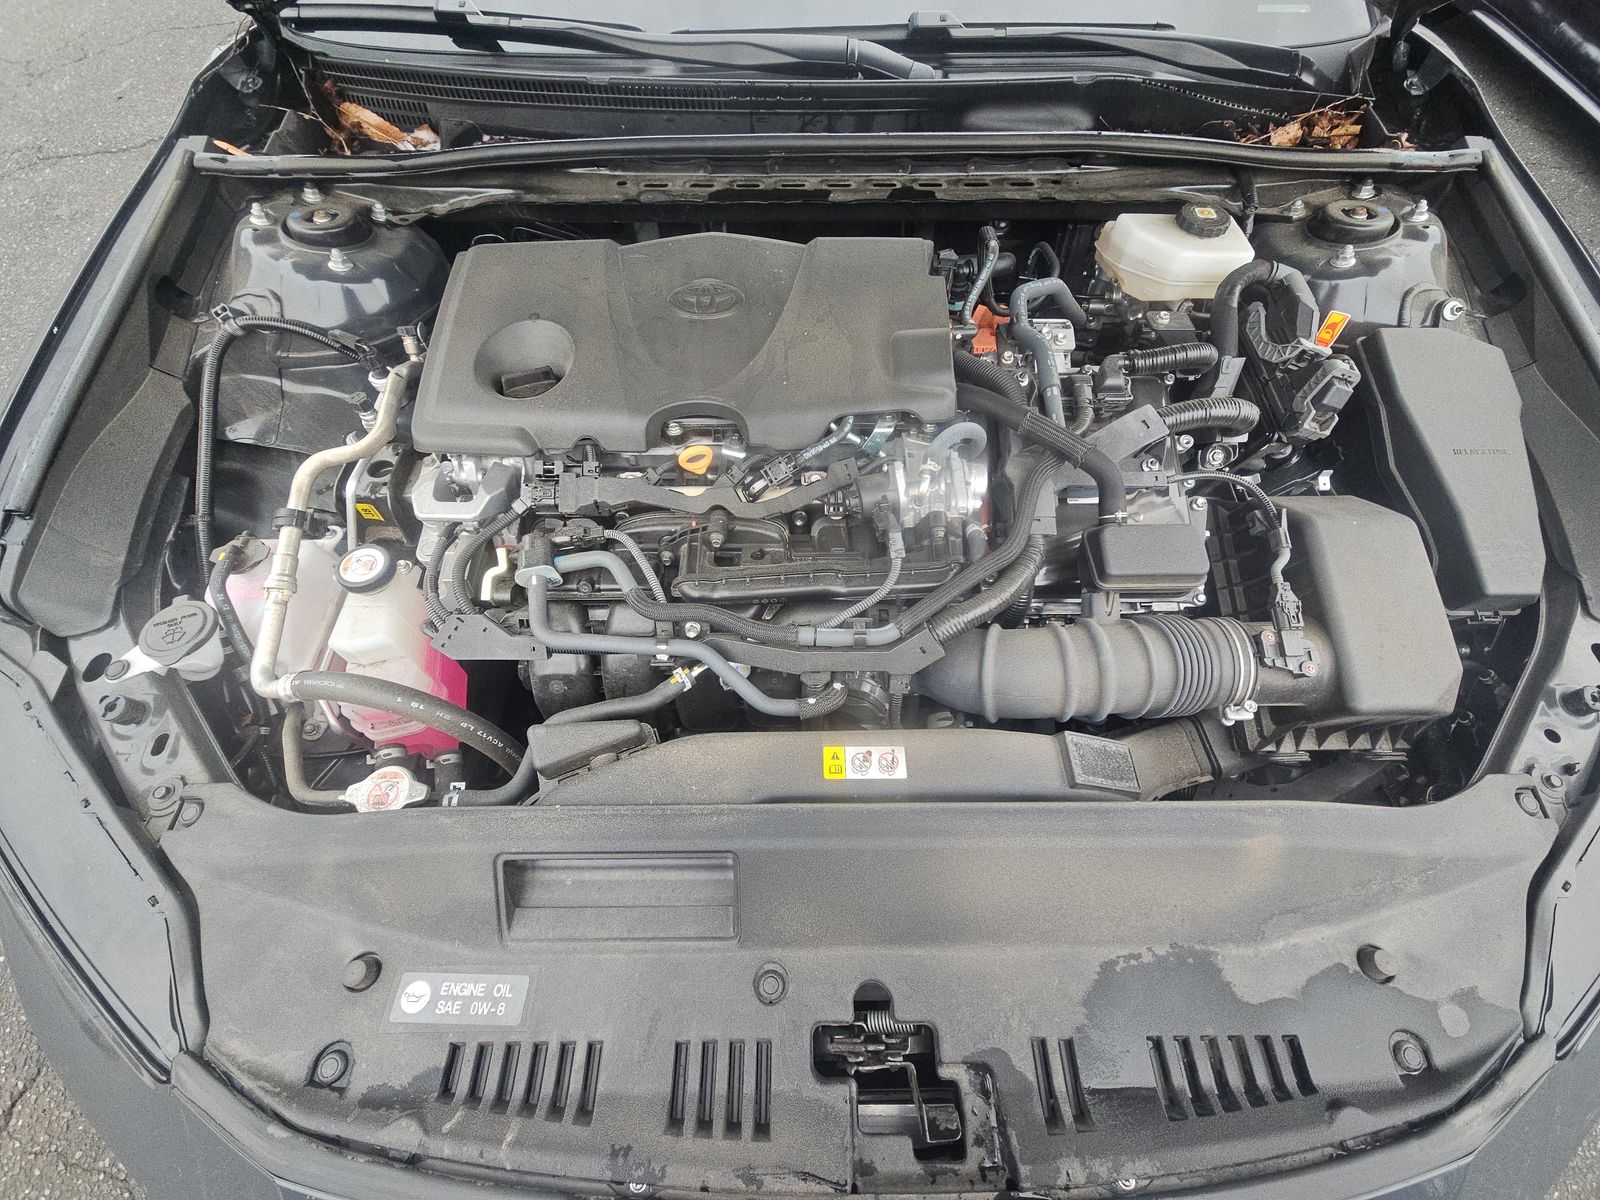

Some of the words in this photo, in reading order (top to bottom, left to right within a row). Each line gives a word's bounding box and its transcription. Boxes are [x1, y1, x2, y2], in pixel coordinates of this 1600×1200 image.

[1452, 448, 1480, 456] RELAY
[476, 730, 504, 748] ACV17
[439, 982, 487, 998] ENGINE
[493, 983, 513, 998] OIL
[435, 1001, 463, 1015] SAE
[470, 1001, 506, 1016] 0W-8
